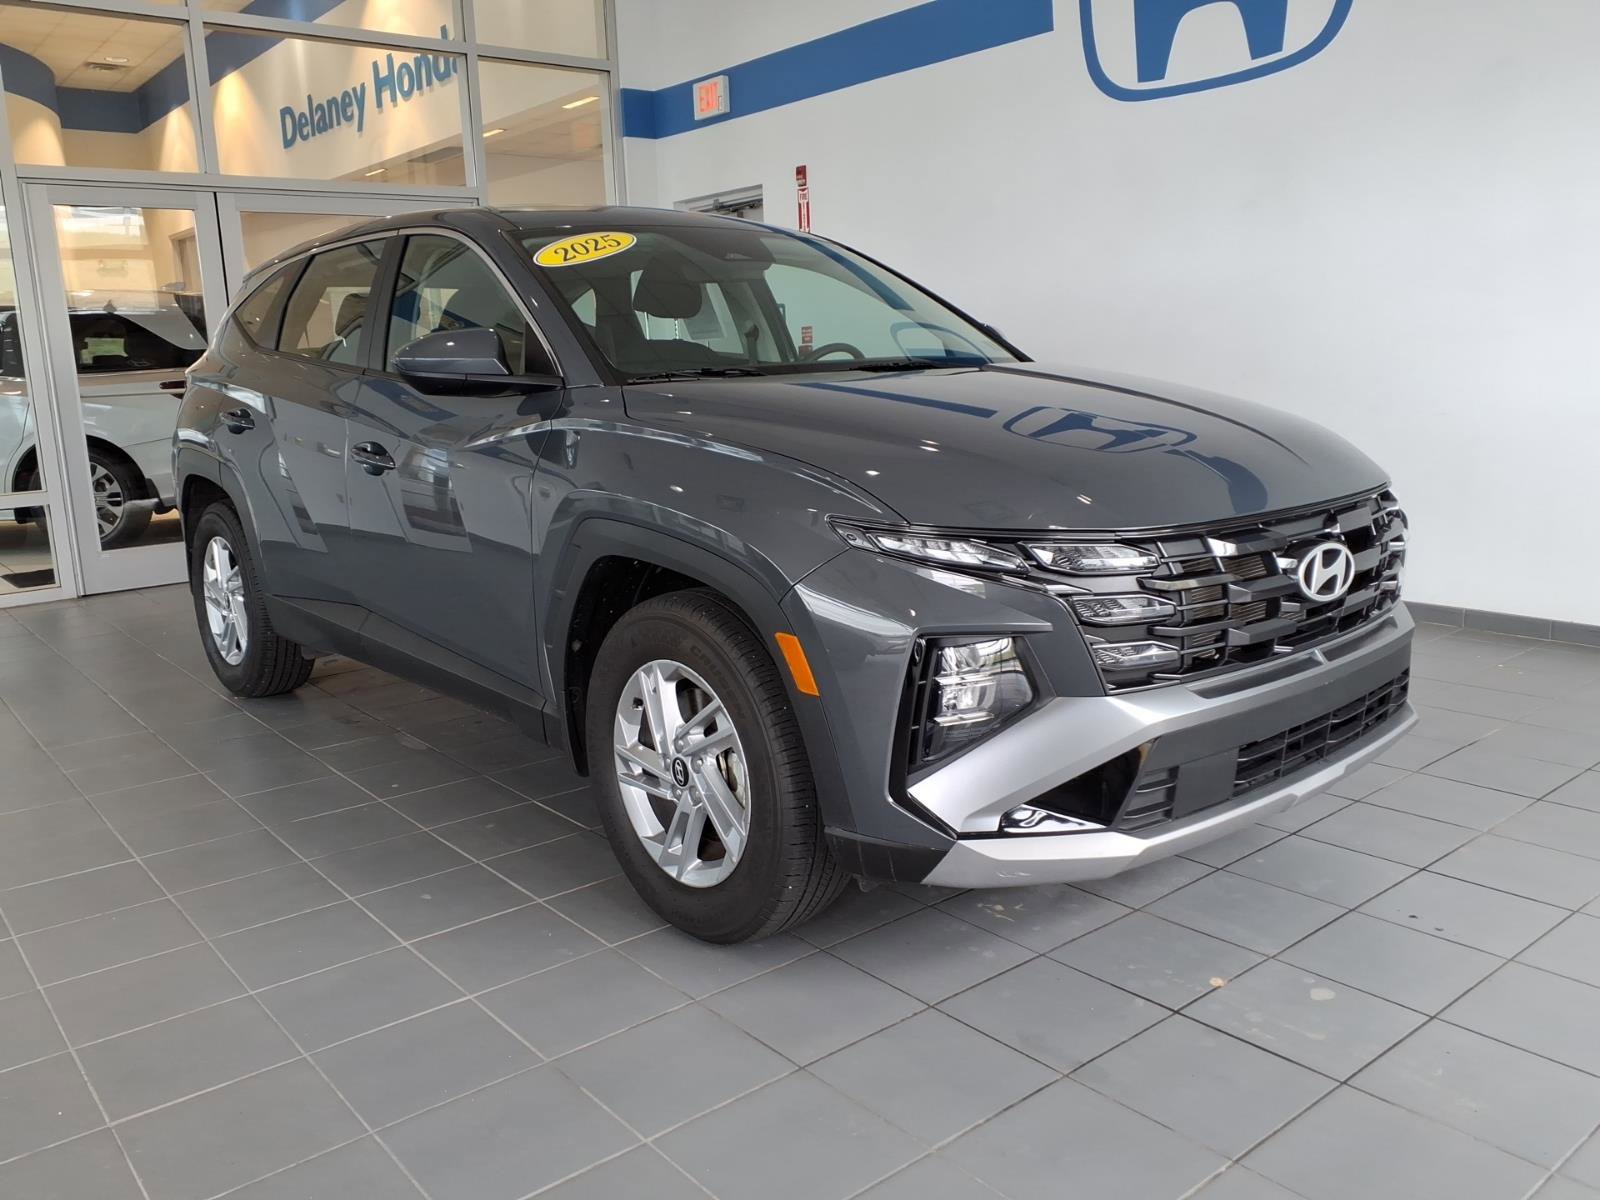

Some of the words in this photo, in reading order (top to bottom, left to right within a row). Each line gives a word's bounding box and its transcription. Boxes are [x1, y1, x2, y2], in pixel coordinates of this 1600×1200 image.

[697, 80, 718, 113] EXIT
[279, 82, 366, 149] Delaney
[553, 234, 622, 262] 2025
